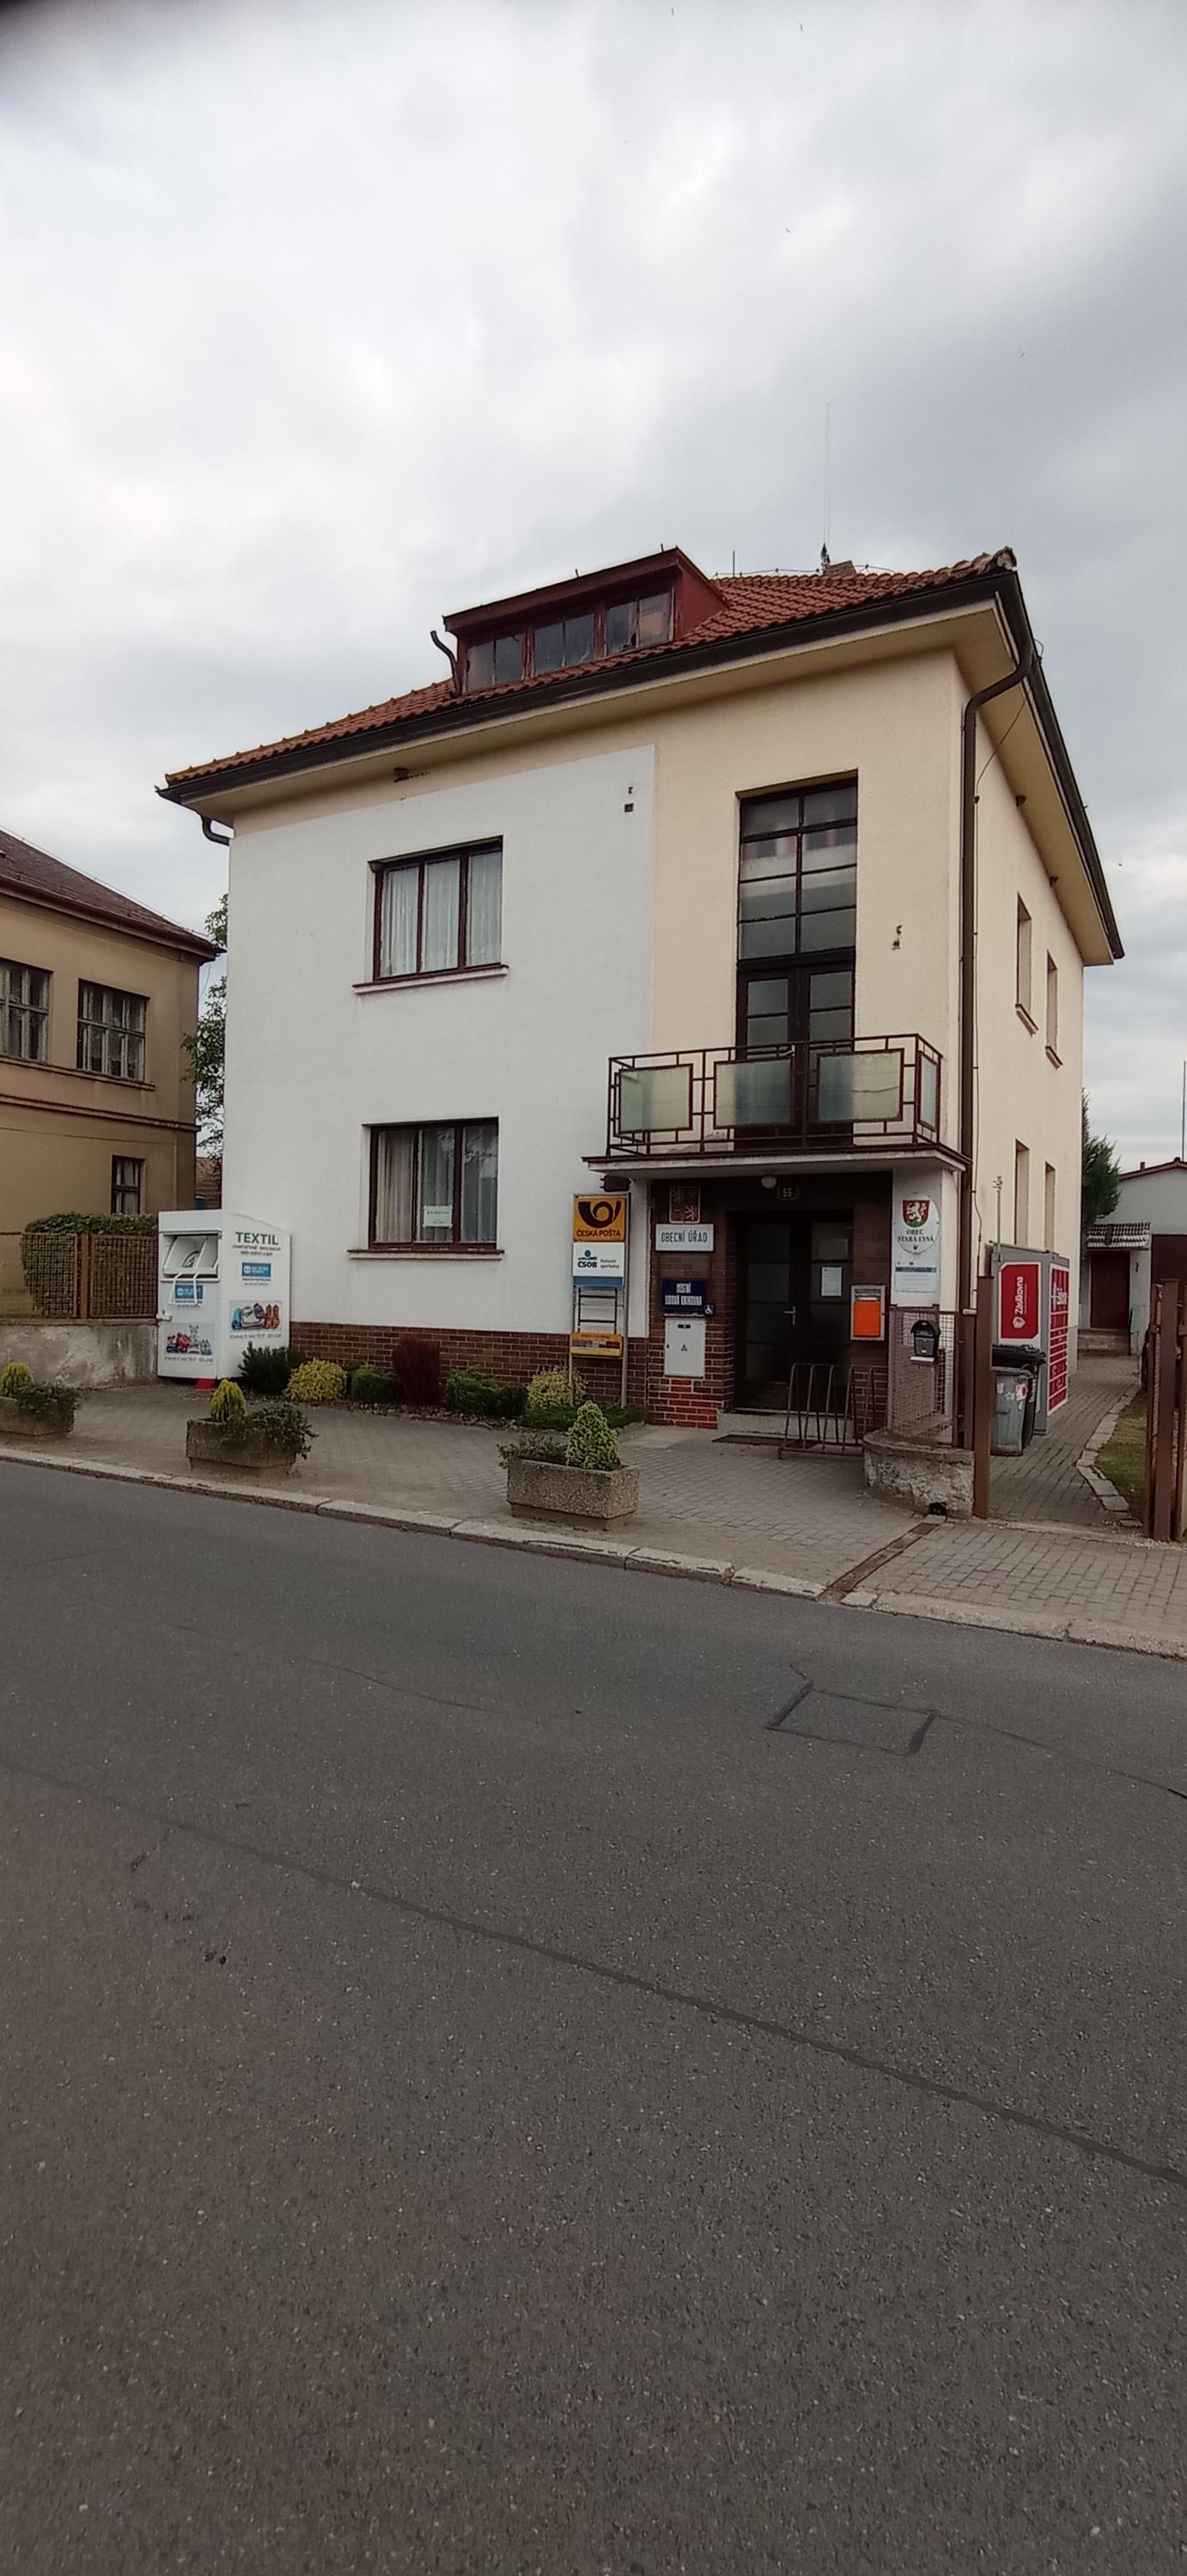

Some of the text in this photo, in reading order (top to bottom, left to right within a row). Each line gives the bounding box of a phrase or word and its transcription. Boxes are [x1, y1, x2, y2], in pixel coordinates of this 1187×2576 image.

[235, 1231, 278, 1245] TEXTIL
[599, 1229, 620, 1237] POŠTA
[660, 1230, 708, 1242] OBECNÍ ÚŘAD
